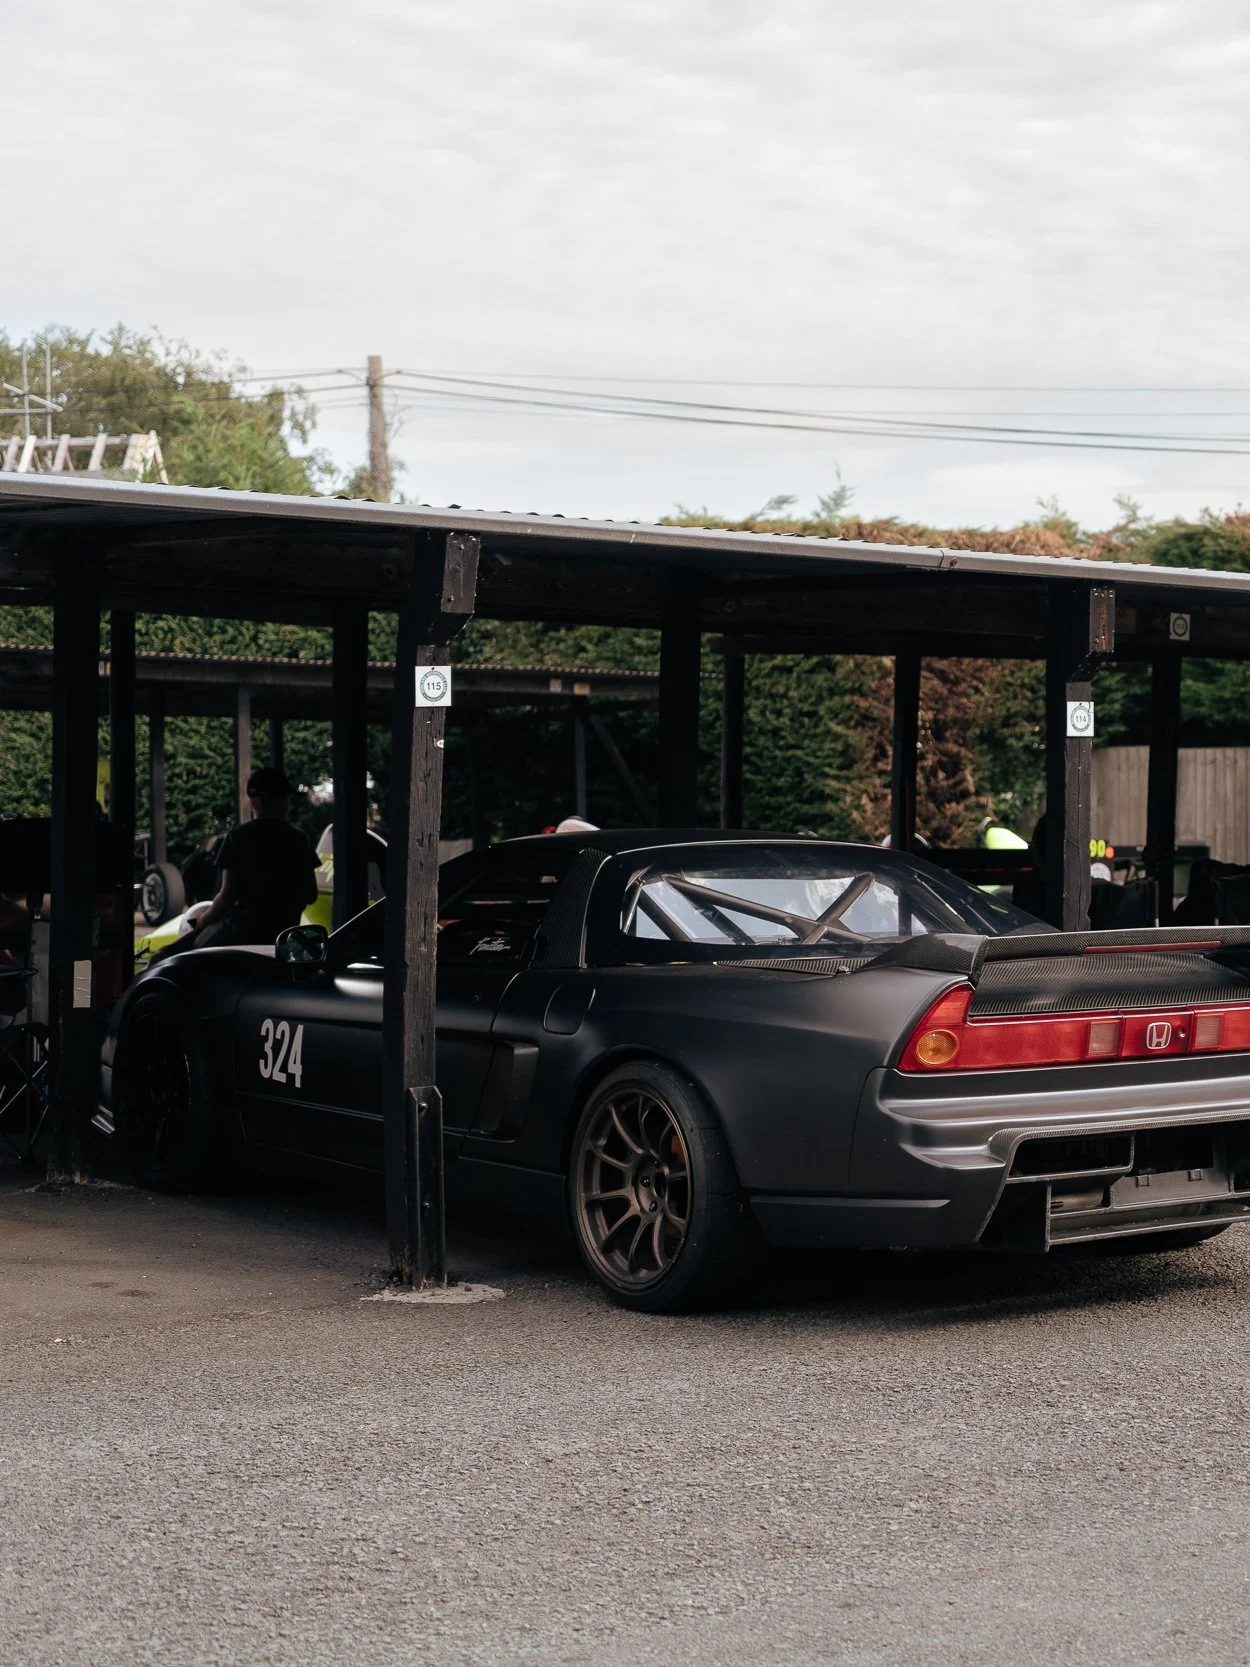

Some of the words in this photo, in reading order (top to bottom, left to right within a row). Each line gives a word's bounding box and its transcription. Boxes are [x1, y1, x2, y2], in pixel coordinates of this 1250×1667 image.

[426, 681, 442, 691] 115
[1075, 715, 1087, 723] 114
[259, 1018, 304, 1088] 324
